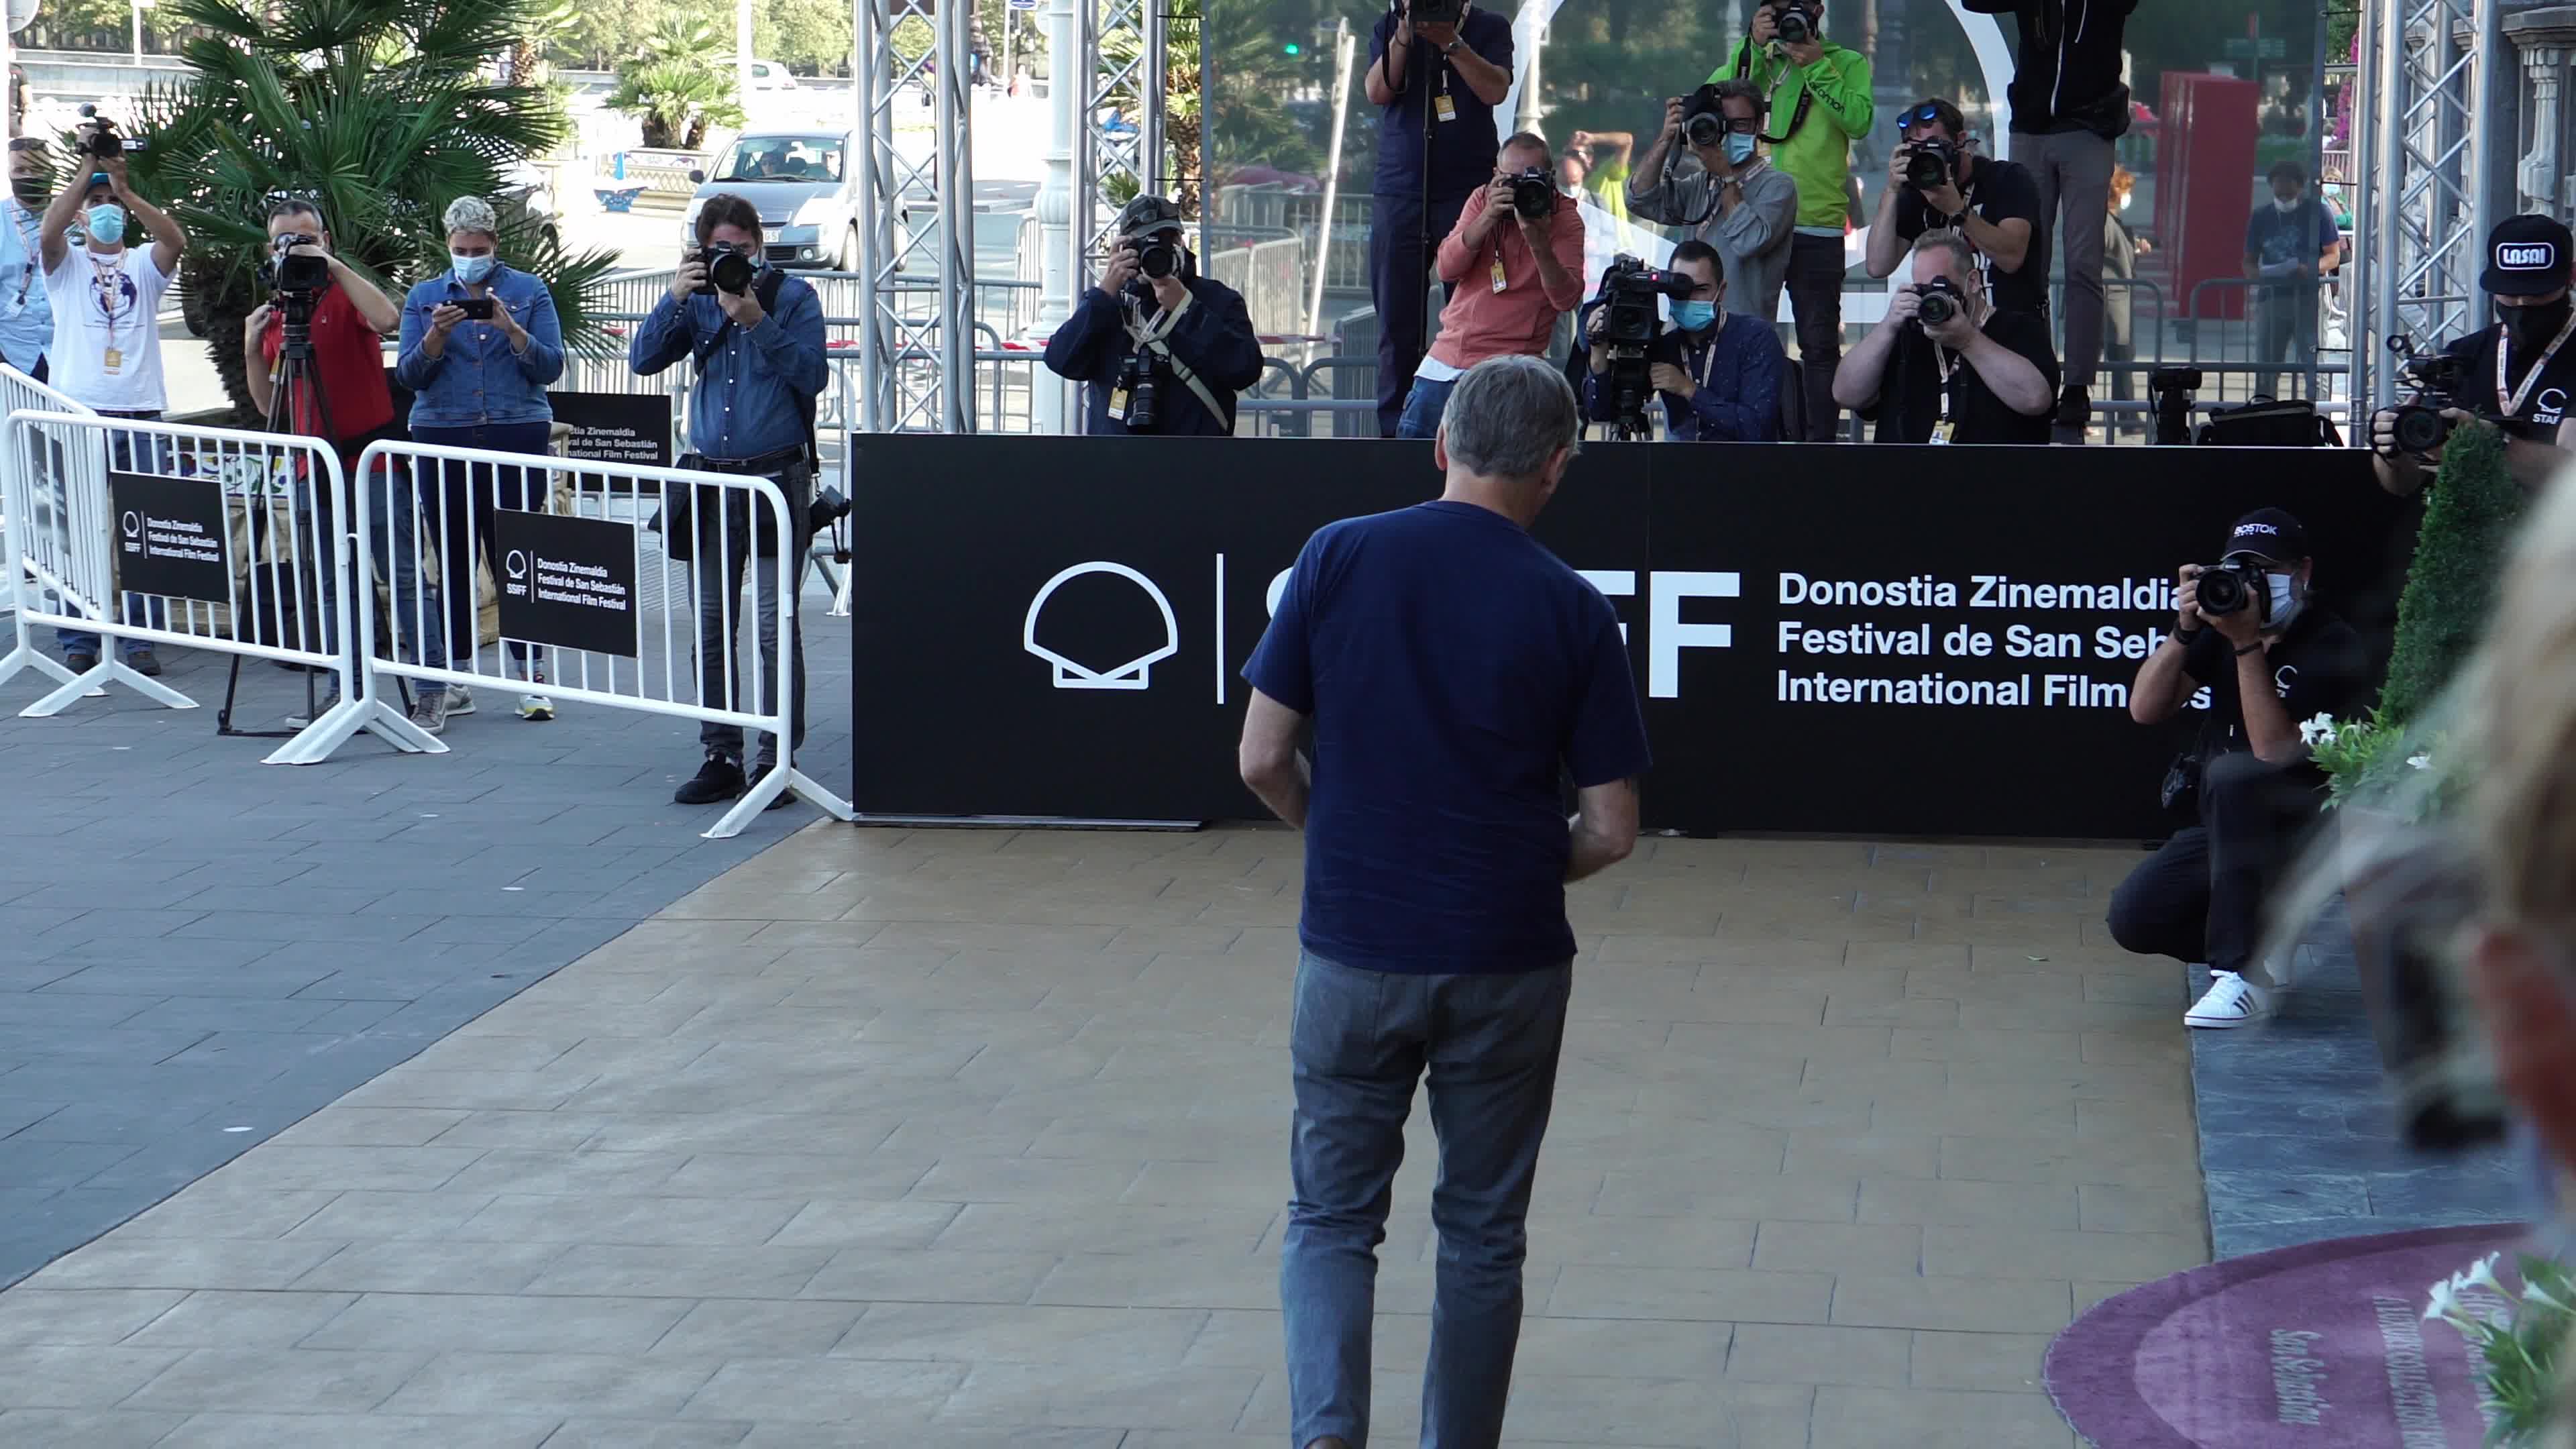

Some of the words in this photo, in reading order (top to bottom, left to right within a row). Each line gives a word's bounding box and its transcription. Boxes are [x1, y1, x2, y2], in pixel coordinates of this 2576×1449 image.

[2503, 248, 2546, 264] LASAI
[2533, 413, 2561, 424] STAF
[587, 427, 636, 437] Zinemaldia
[582, 438, 593, 446] de
[595, 438, 612, 447] San
[614, 438, 658, 449] Sebastián
[603, 449, 622, 458] Film
[624, 450, 658, 460] Festival
[537, 557, 568, 572] Donostia
[568, 562, 608, 578] Zinemaldia
[506, 583, 527, 596] SSIFF
[537, 573, 564, 587] Festival
[565, 578, 575, 588] de
[575, 578, 590, 590] San
[590, 580, 626, 595] Sebastián
[1779, 572, 1957, 606] Donostia
[538, 588, 582, 604] International
[582, 594, 598, 606] Film
[598, 596, 626, 610] Festival
[1778, 621, 1930, 655] Festival
[1943, 624, 1993, 657] de
[2004, 625, 2081, 658] San
[1778, 669, 2030, 706] International
[2044, 674, 2127, 708] Film
